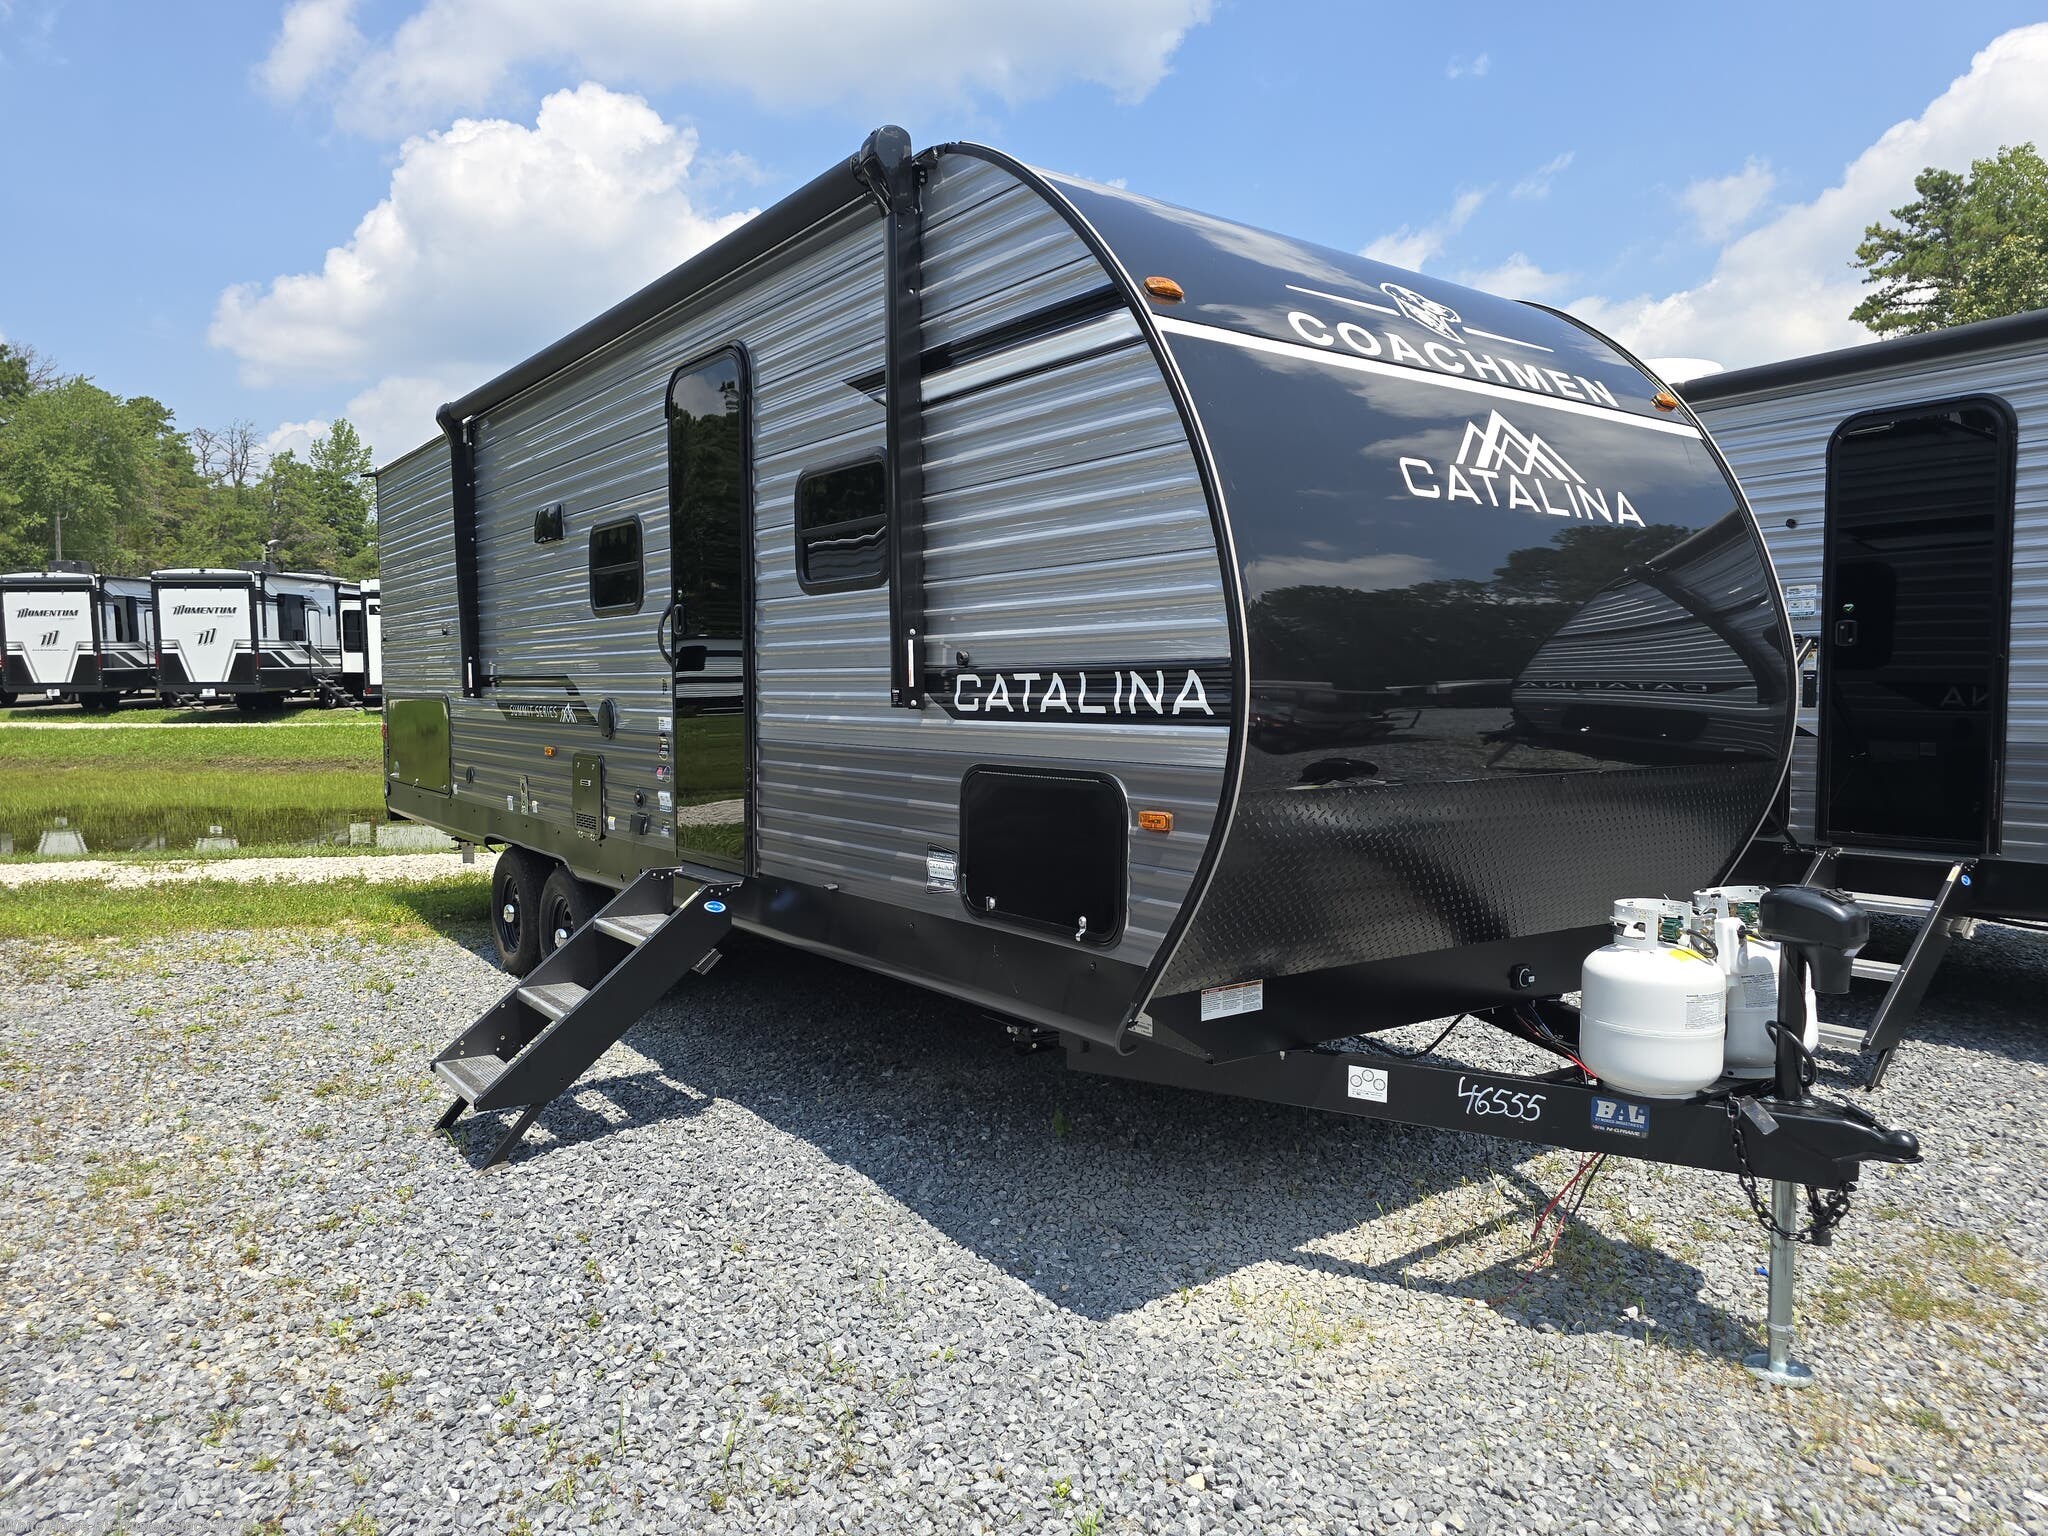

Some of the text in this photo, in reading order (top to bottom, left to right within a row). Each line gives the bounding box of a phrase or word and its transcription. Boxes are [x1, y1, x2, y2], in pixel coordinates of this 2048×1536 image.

[1287, 311, 1620, 407] COACHMEN
[1398, 456, 1646, 528] CATALINA
[509, 704, 558, 719] SUMMIT SERIES
[953, 669, 1214, 716] CATALINA
[1457, 1076, 1547, 1122] 46555
[1596, 1100, 1645, 1124] BAL
